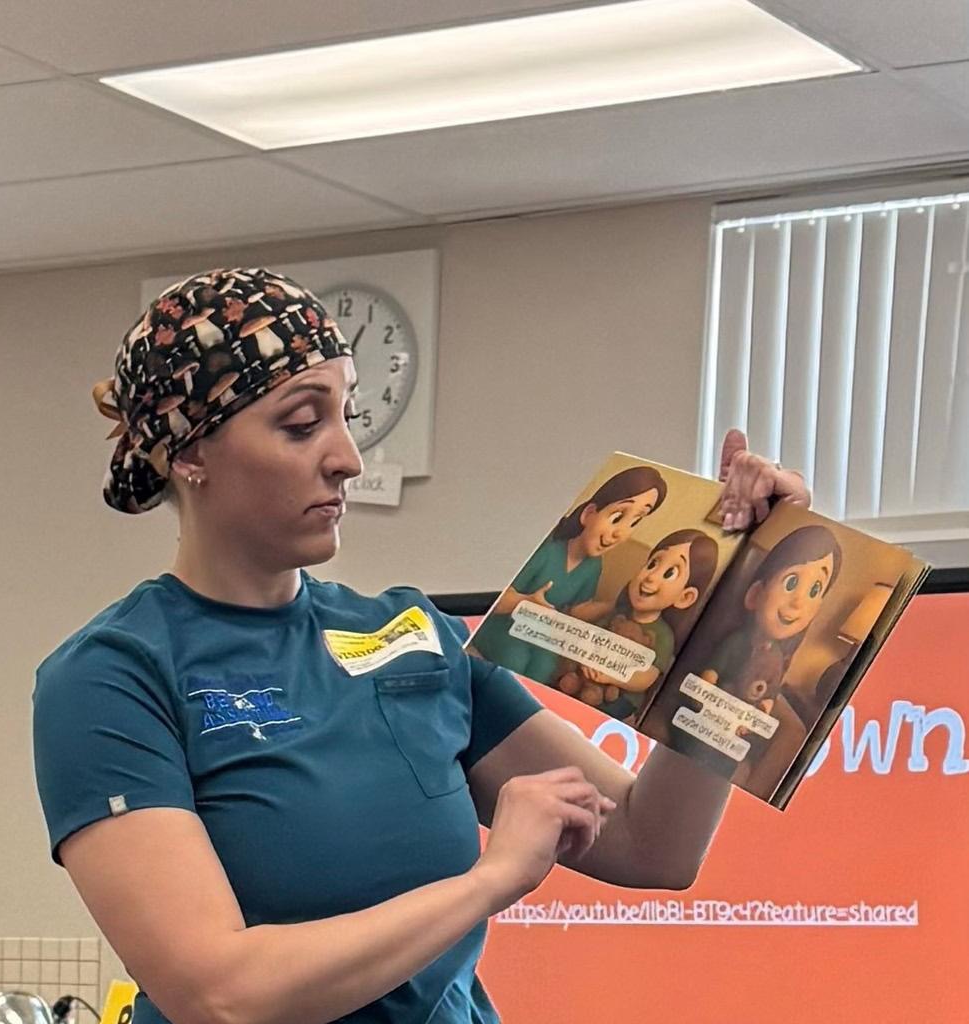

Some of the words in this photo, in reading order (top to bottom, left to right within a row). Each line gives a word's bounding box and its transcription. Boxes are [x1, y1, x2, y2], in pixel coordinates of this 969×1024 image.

[337, 298, 352, 317] 12
[367, 304, 373, 323] 1
[383, 325, 394, 344] 2
[390, 354, 400, 373] 3
[382, 386, 392, 405] 4
[361, 409, 372, 427] 5
[565, 623, 591, 640] scrub
[567, 644, 587, 658] care
[587, 650, 607, 665] and
